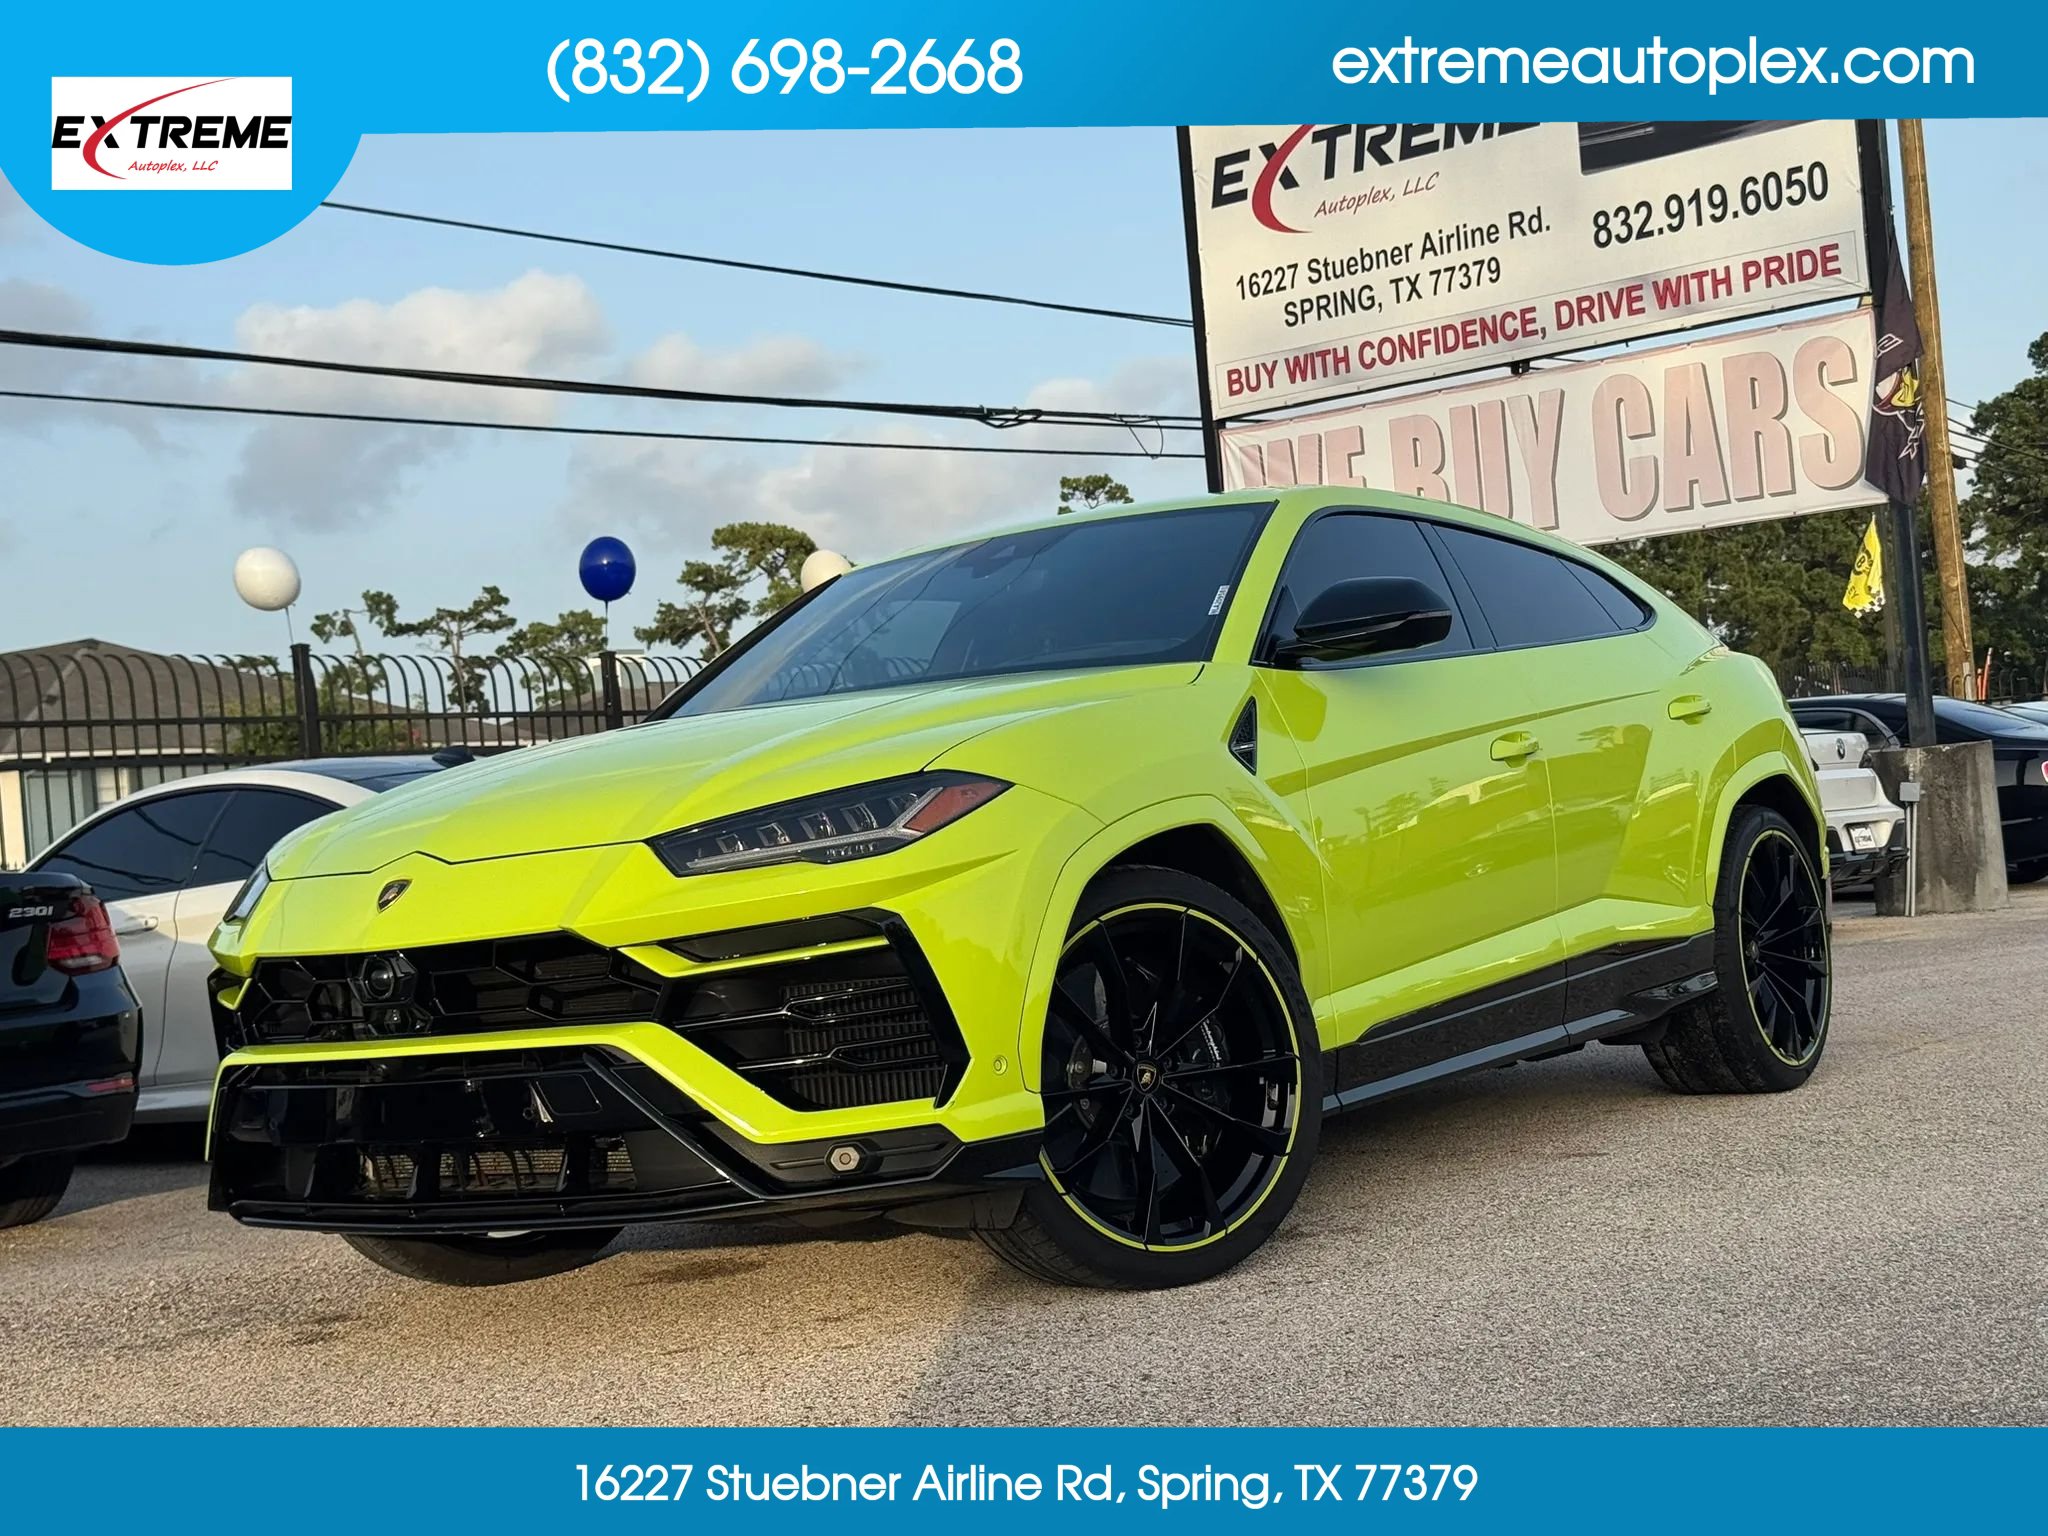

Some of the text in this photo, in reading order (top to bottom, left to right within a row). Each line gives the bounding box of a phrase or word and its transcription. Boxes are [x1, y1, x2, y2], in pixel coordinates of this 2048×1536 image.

[1212, 122, 1540, 208] EXTREM
[1313, 171, 1439, 218] Autoplex, LLC
[1593, 162, 1829, 249] 832.919.6050
[1236, 205, 1552, 300] 16227 Stuebner Airline Rd.
[1284, 257, 1501, 328] SPRING, TX 77379
[1227, 244, 1841, 396] BUY WITH CONFIDENCE, DRIVE WITH PRIDE
[1389, 388, 1565, 530] BUY
[1592, 336, 1865, 521] CARS
